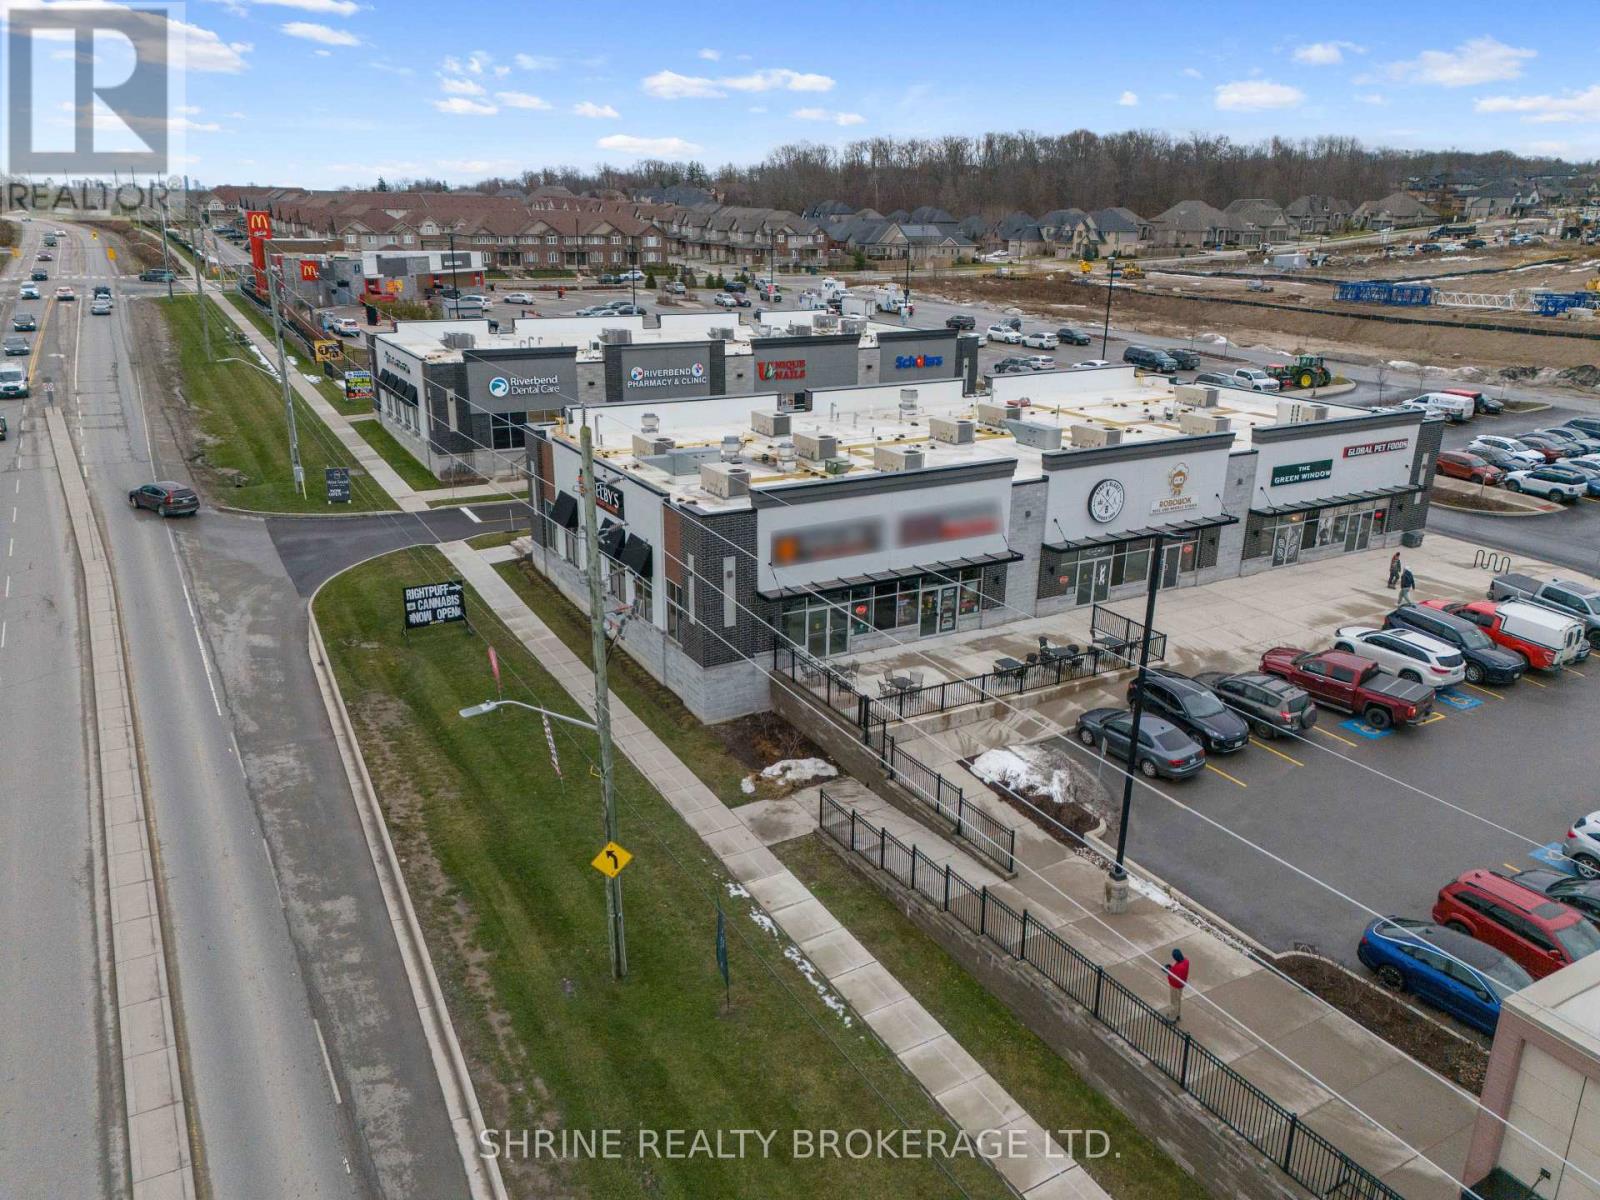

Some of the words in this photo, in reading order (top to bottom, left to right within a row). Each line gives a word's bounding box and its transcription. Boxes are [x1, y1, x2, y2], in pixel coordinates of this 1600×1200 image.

[644, 368, 691, 378] RIVERBEND
[775, 369, 806, 380] NAILS
[510, 375, 558, 386] Riverbend
[627, 379, 672, 388] PHARMACY
[681, 376, 707, 385] CLINIC
[511, 385, 539, 395] Dental
[540, 384, 560, 393] Care
[1347, 445, 1372, 456] GLOBAL
[1374, 442, 1386, 452] PET
[1387, 440, 1408, 451] FOODS
[1274, 474, 1300, 484] GREEN
[1301, 470, 1331, 480] WINDOW
[405, 583, 449, 600] RIGHTPUFF
[417, 594, 460, 611] CANNABIS
